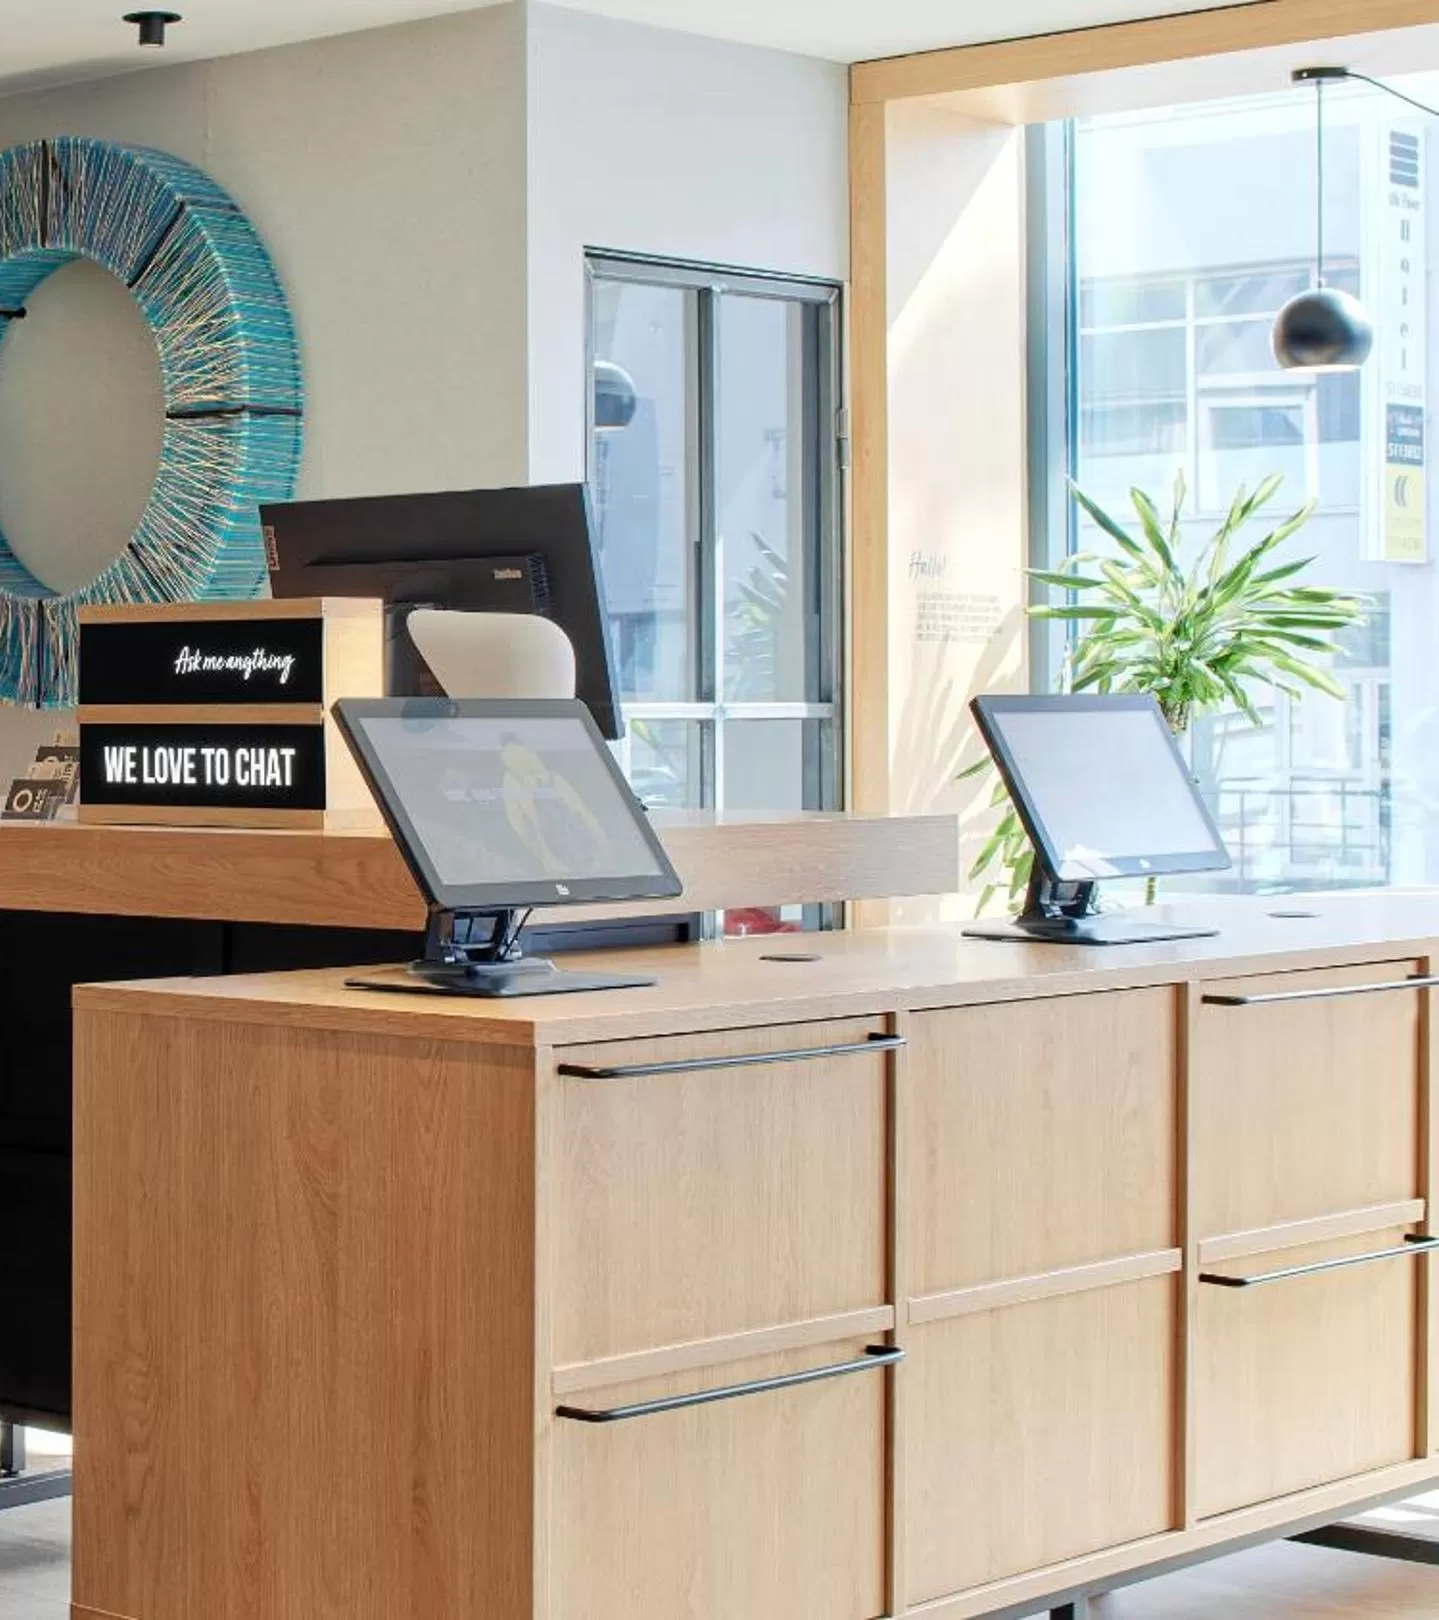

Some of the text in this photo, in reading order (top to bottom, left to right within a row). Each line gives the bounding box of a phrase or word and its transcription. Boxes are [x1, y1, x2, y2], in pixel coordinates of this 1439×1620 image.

[174, 646, 296, 684] Ask me anything
[104, 746, 137, 783] WE
[143, 747, 197, 784] LOVE
[200, 748, 229, 785] TO
[235, 748, 295, 786] CHAT
